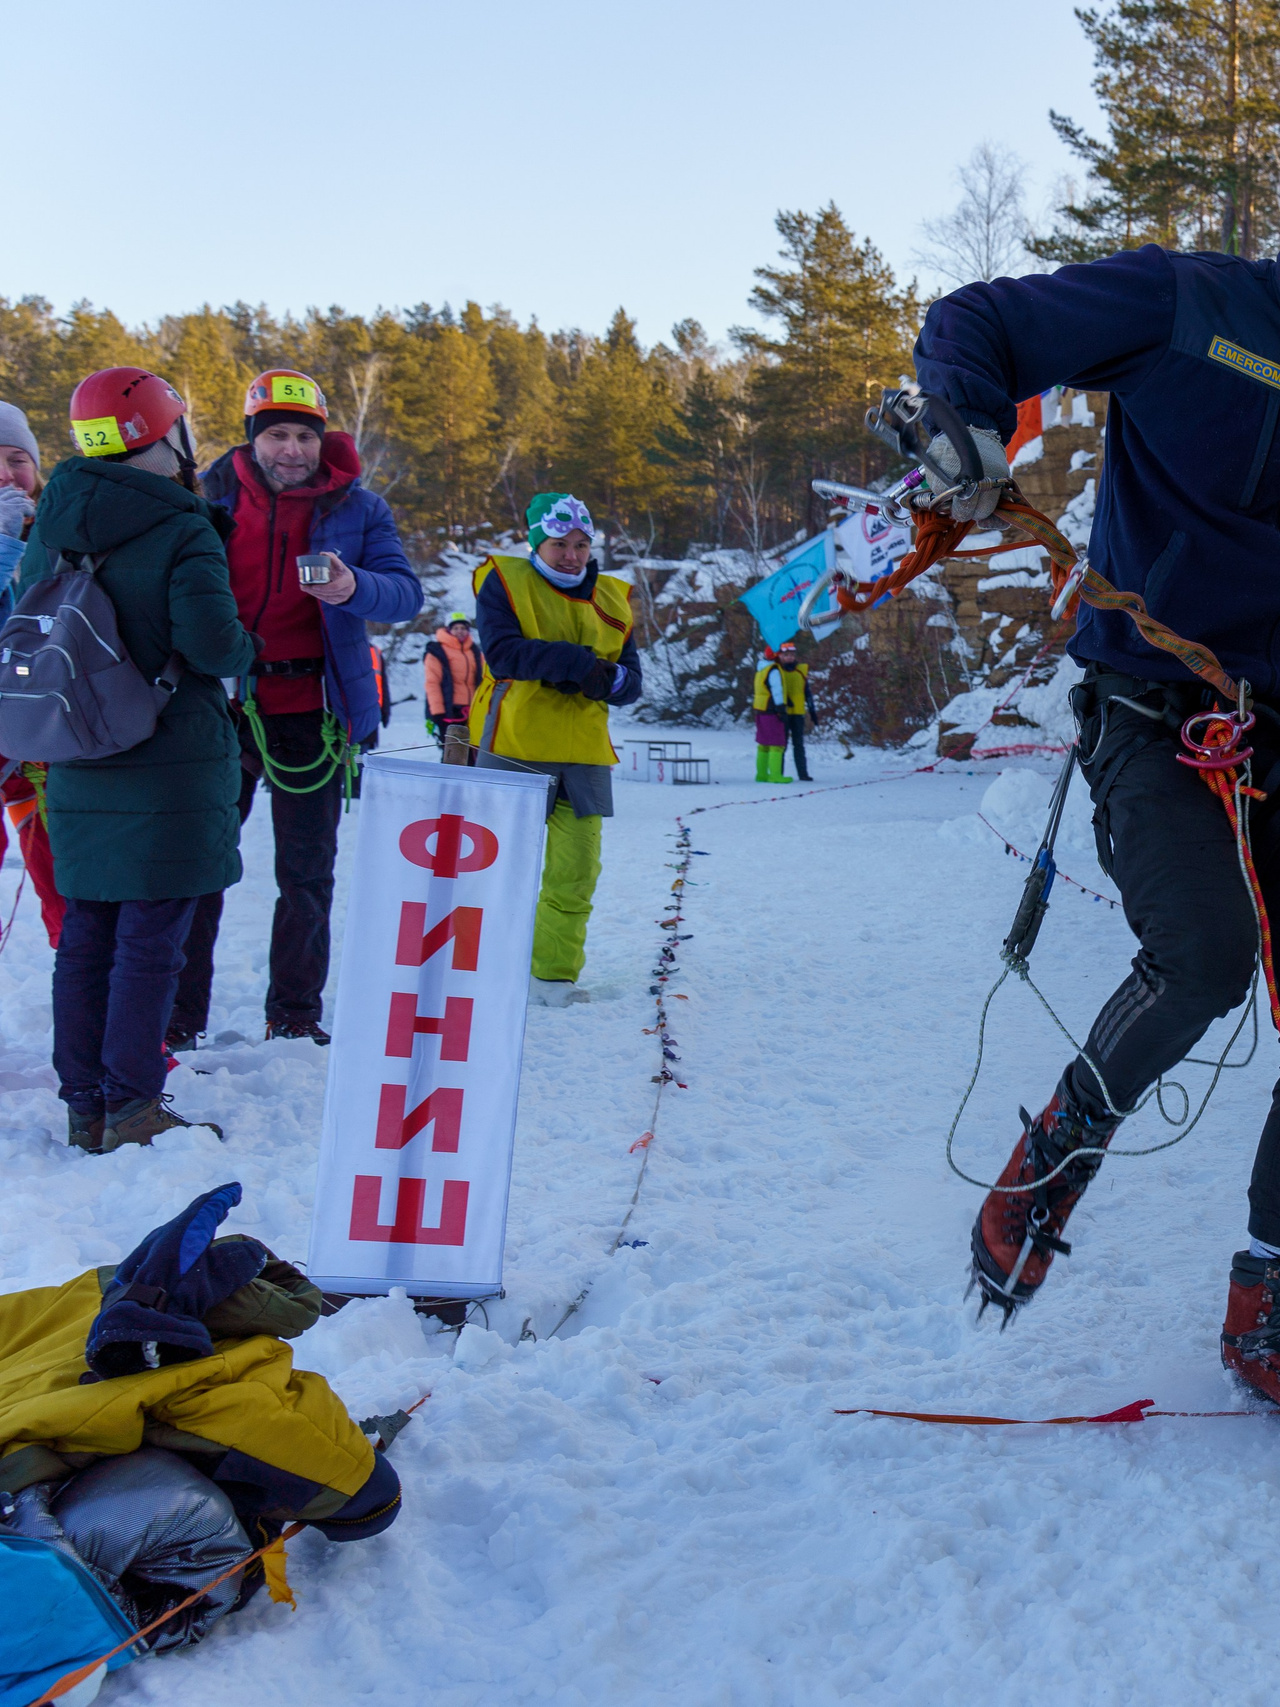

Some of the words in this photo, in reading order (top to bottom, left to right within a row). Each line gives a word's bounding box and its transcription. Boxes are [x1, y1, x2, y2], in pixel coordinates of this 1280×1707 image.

[284, 384, 306, 398] 5.1
[83, 430, 110, 447] 5.2
[656, 760, 665, 783] 3
[348, 813, 499, 1246] ФИНИШ
